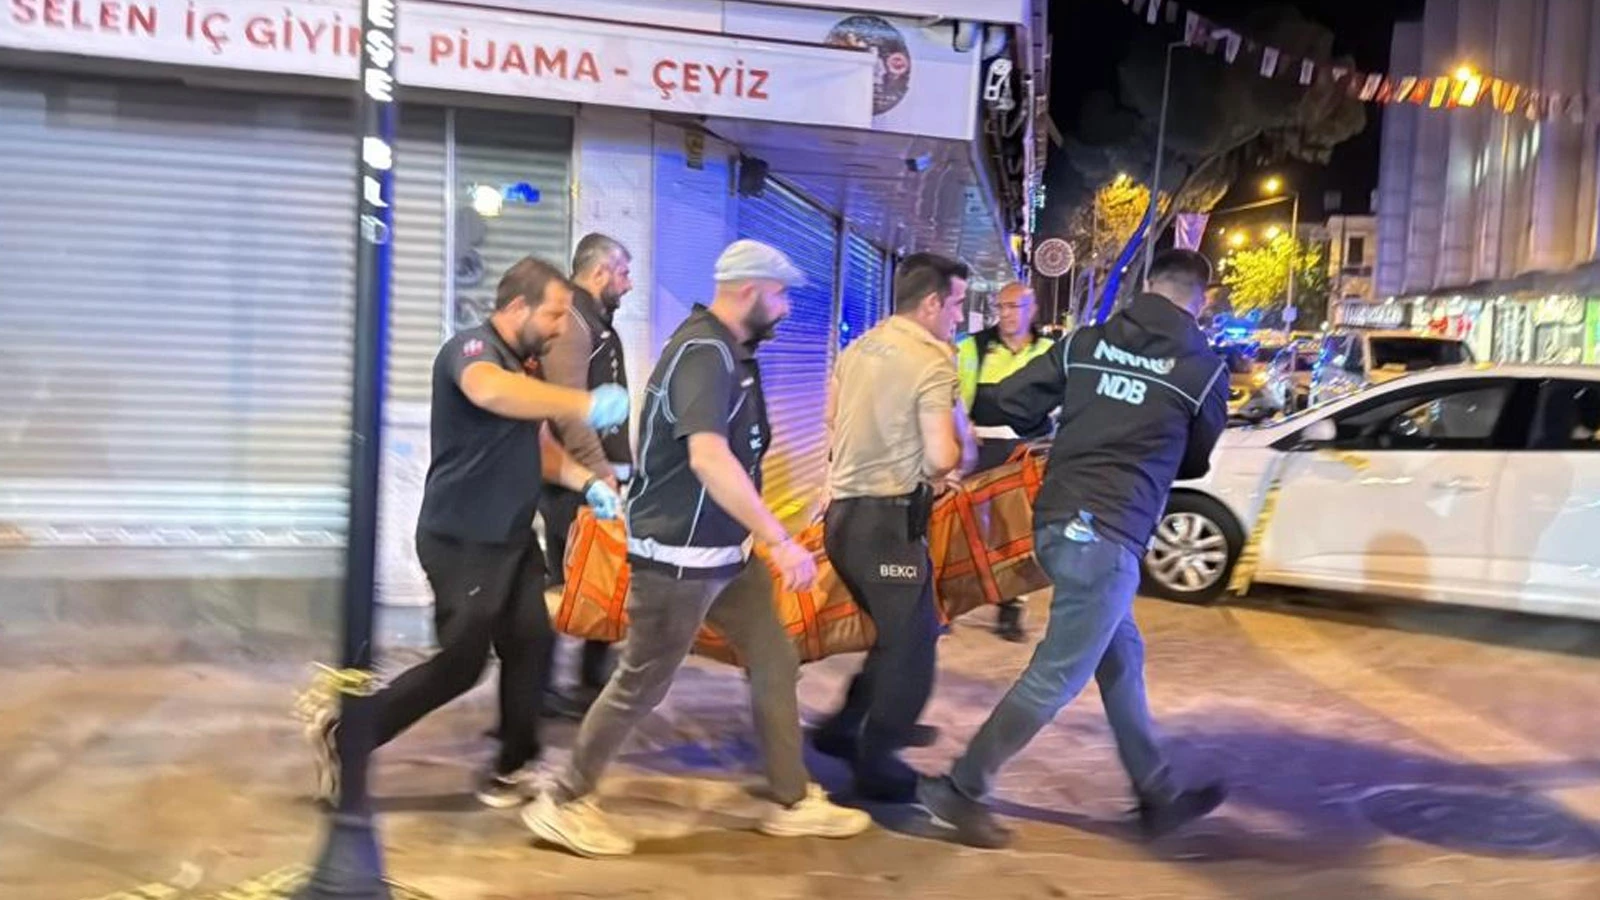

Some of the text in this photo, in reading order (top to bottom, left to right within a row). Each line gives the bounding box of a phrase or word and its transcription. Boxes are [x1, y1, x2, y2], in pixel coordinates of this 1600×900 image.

[11, 0, 157, 38] SELEN
[186, 0, 230, 55] İÇ
[429, 28, 600, 83] PİJAMA
[652, 59, 770, 100] ÇEYİZ
[1096, 372, 1148, 405] NDB
